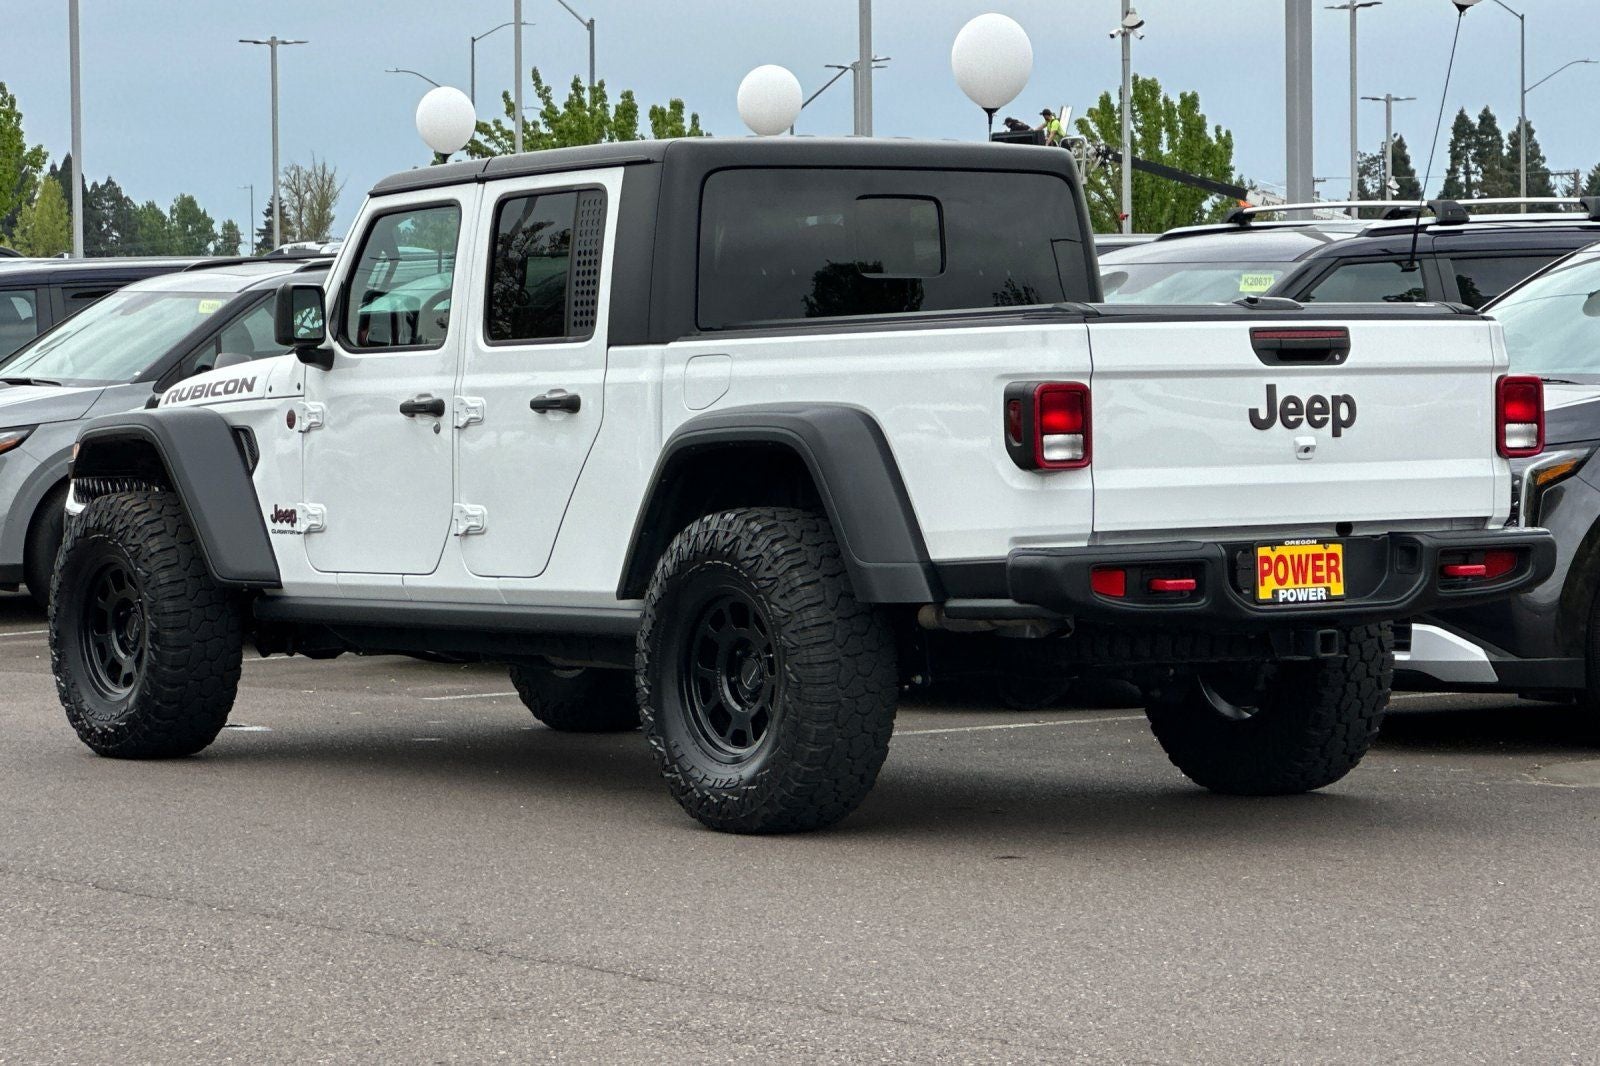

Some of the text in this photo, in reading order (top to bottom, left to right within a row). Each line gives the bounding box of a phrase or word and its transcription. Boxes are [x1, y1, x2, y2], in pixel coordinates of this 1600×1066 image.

[164, 376, 257, 405] RUBICON
[1249, 384, 1357, 437] Jeep
[270, 504, 297, 527] Jeep
[1259, 552, 1341, 587] POWER
[1279, 587, 1327, 602] POWER
